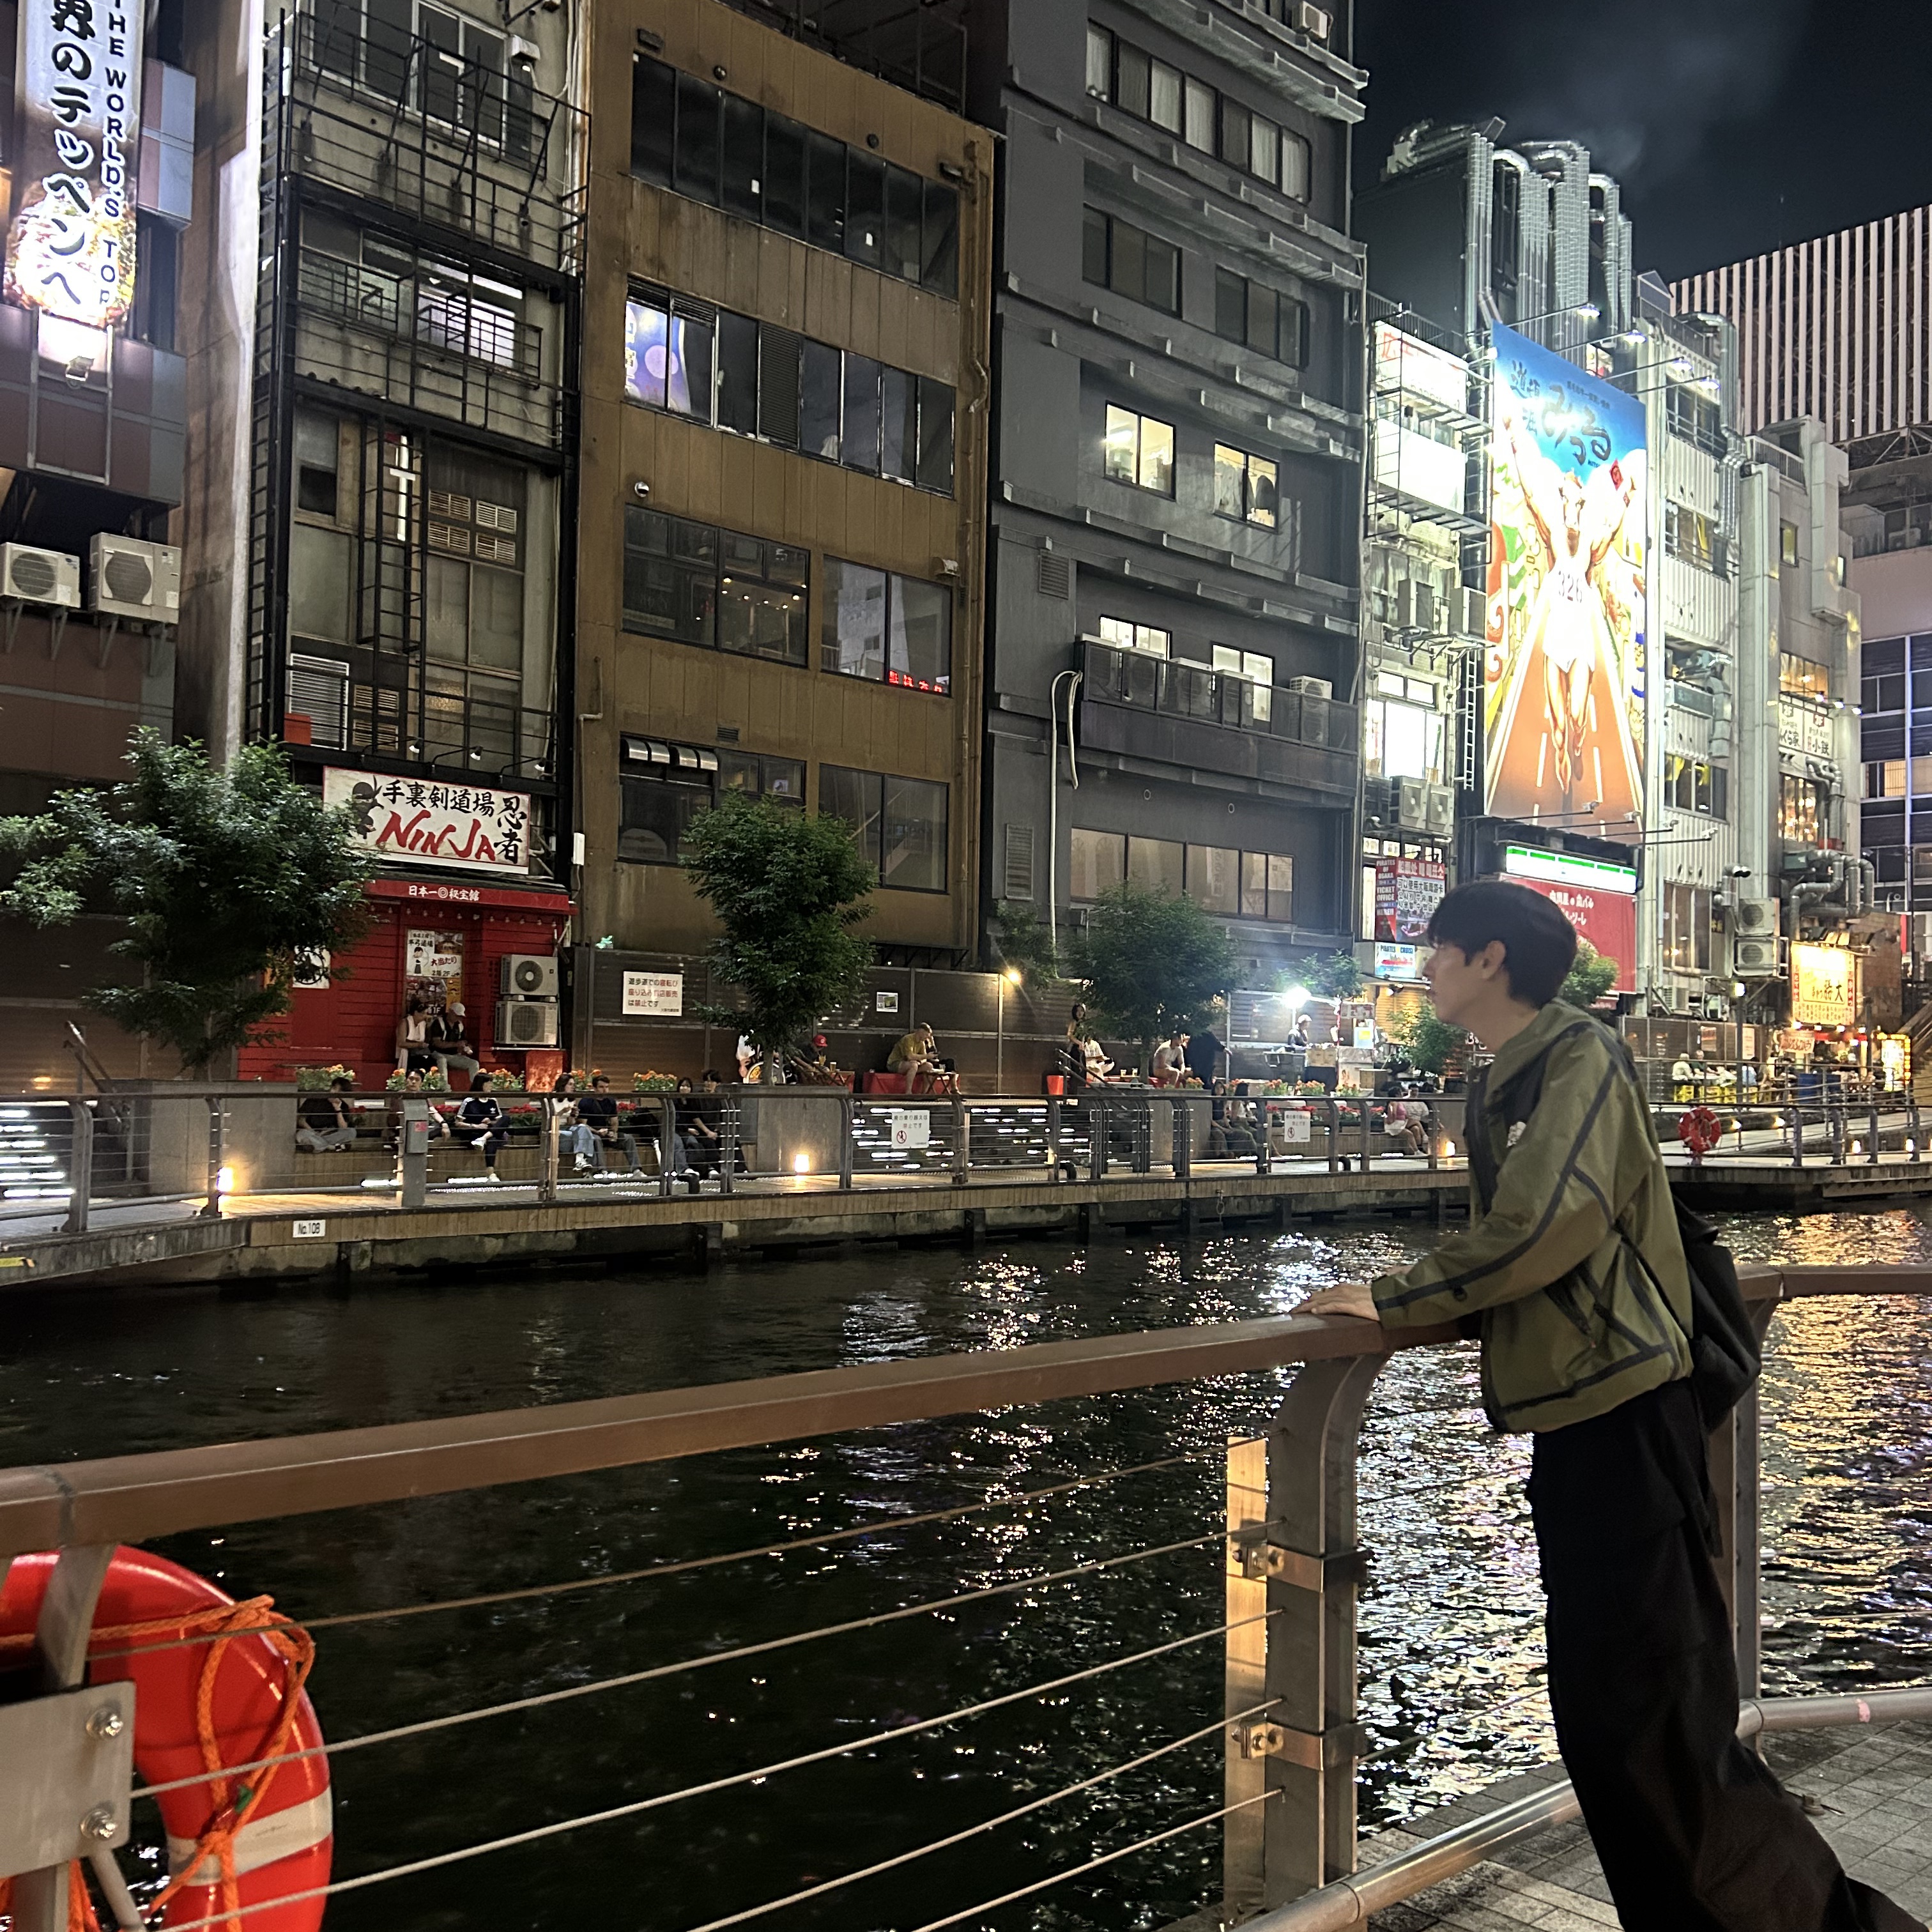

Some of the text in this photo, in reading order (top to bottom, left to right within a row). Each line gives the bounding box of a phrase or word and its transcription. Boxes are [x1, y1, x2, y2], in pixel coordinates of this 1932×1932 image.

[102, 66, 126, 218] WORLD'S
[382, 779, 496, 818] 手裏剣道場
[376, 809, 498, 862] NINJA
[493, 795, 528, 864] 忍者
[431, 956, 457, 967] 大当たり
